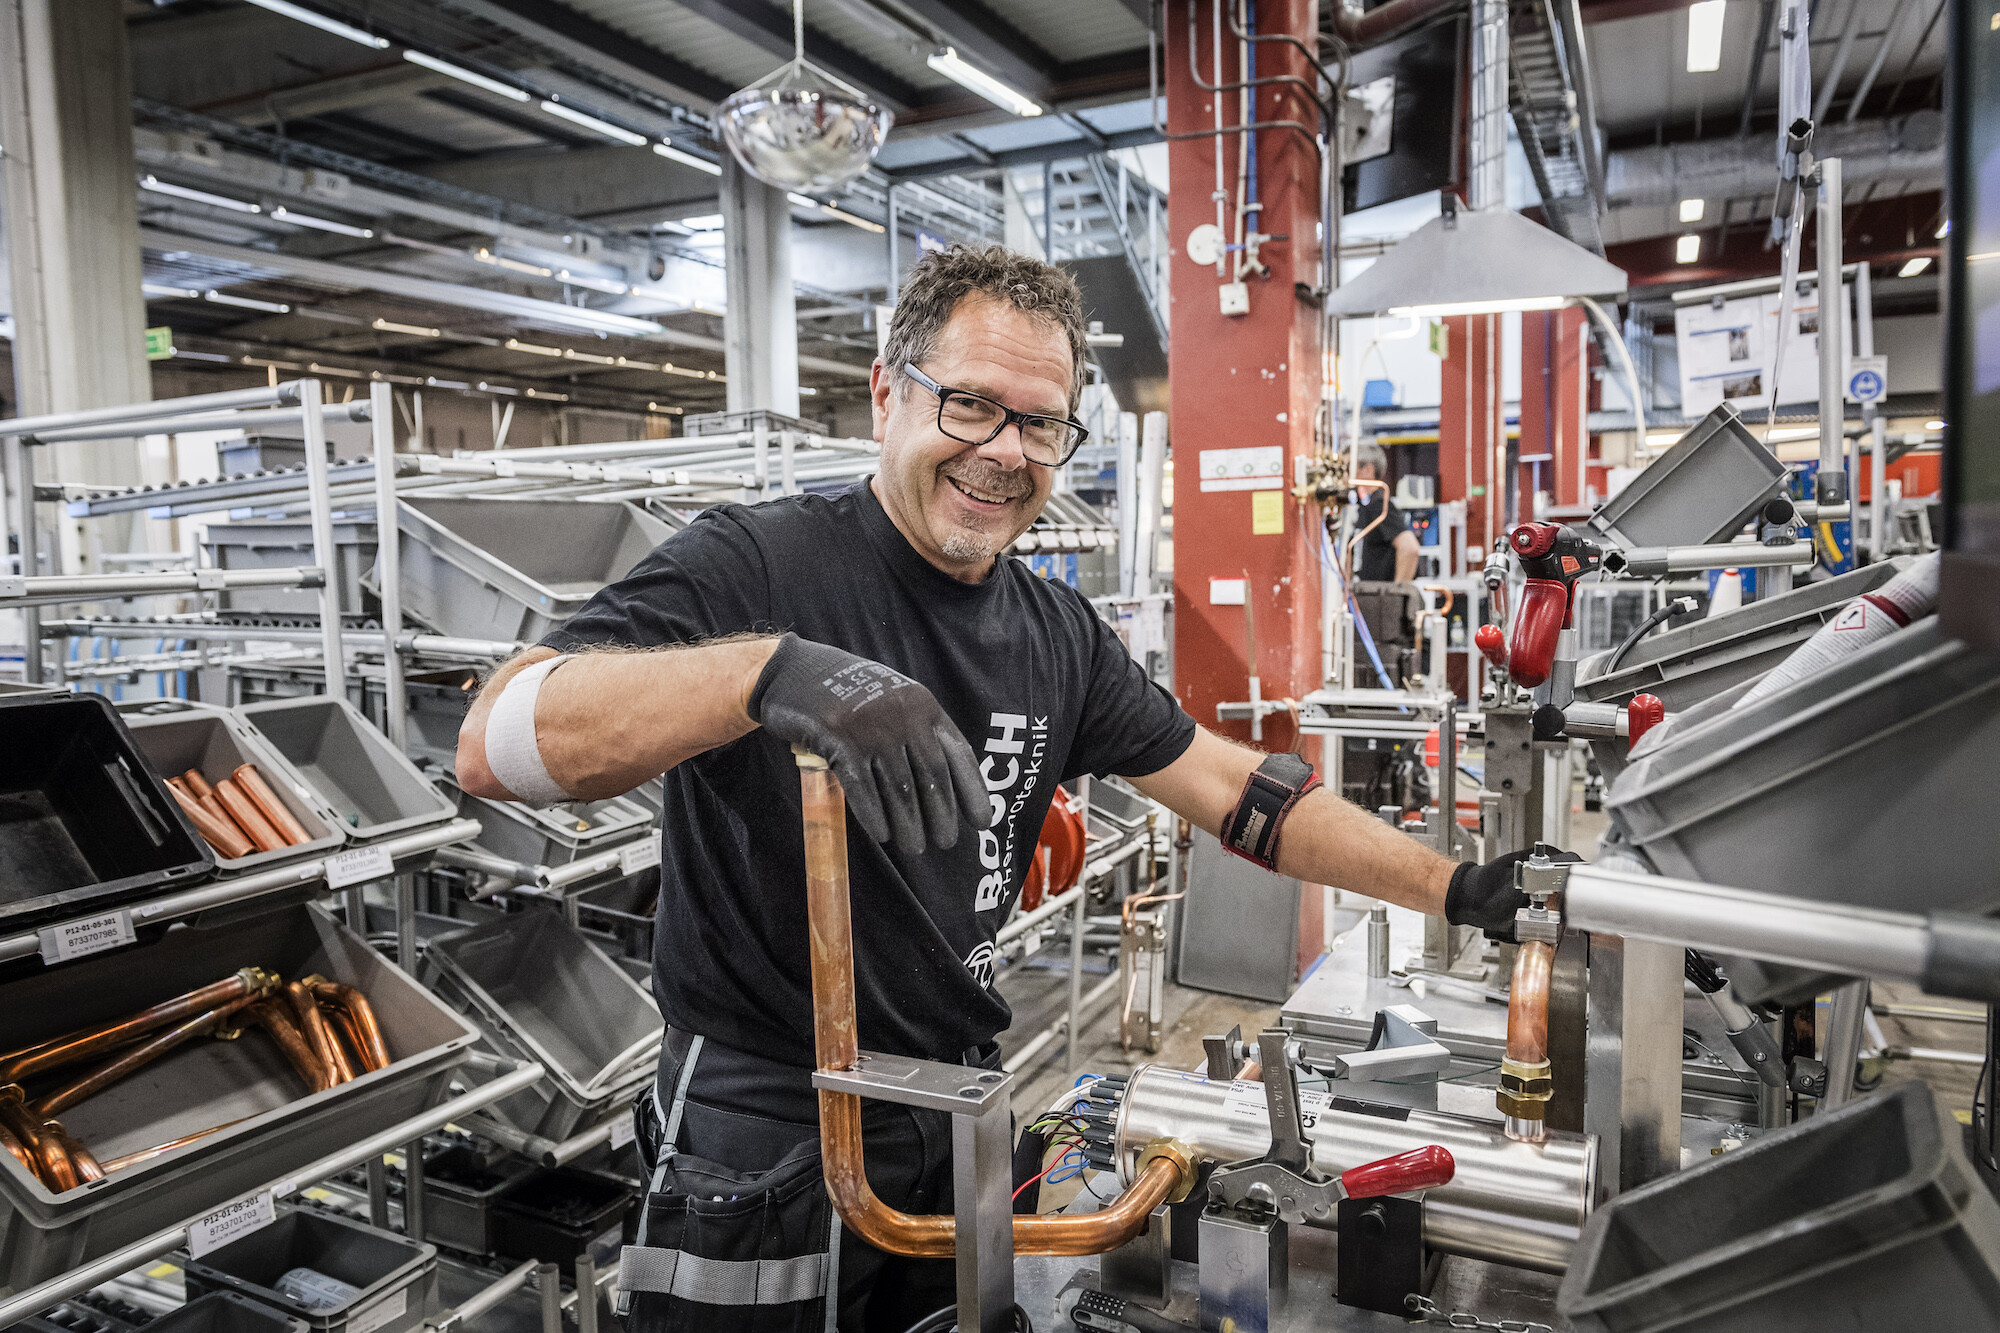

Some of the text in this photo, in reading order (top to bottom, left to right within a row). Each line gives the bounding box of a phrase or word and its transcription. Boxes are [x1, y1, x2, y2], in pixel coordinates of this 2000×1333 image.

[1001, 715, 1048, 904] Thermoteknik
[1234, 806, 1259, 850] Rehband
[65, 918, 116, 935] P12-01-05-301
[68, 928, 118, 947] 8733707985
[204, 1196, 259, 1227] P12-01-05-201
[210, 1209, 257, 1236] 8733701703
